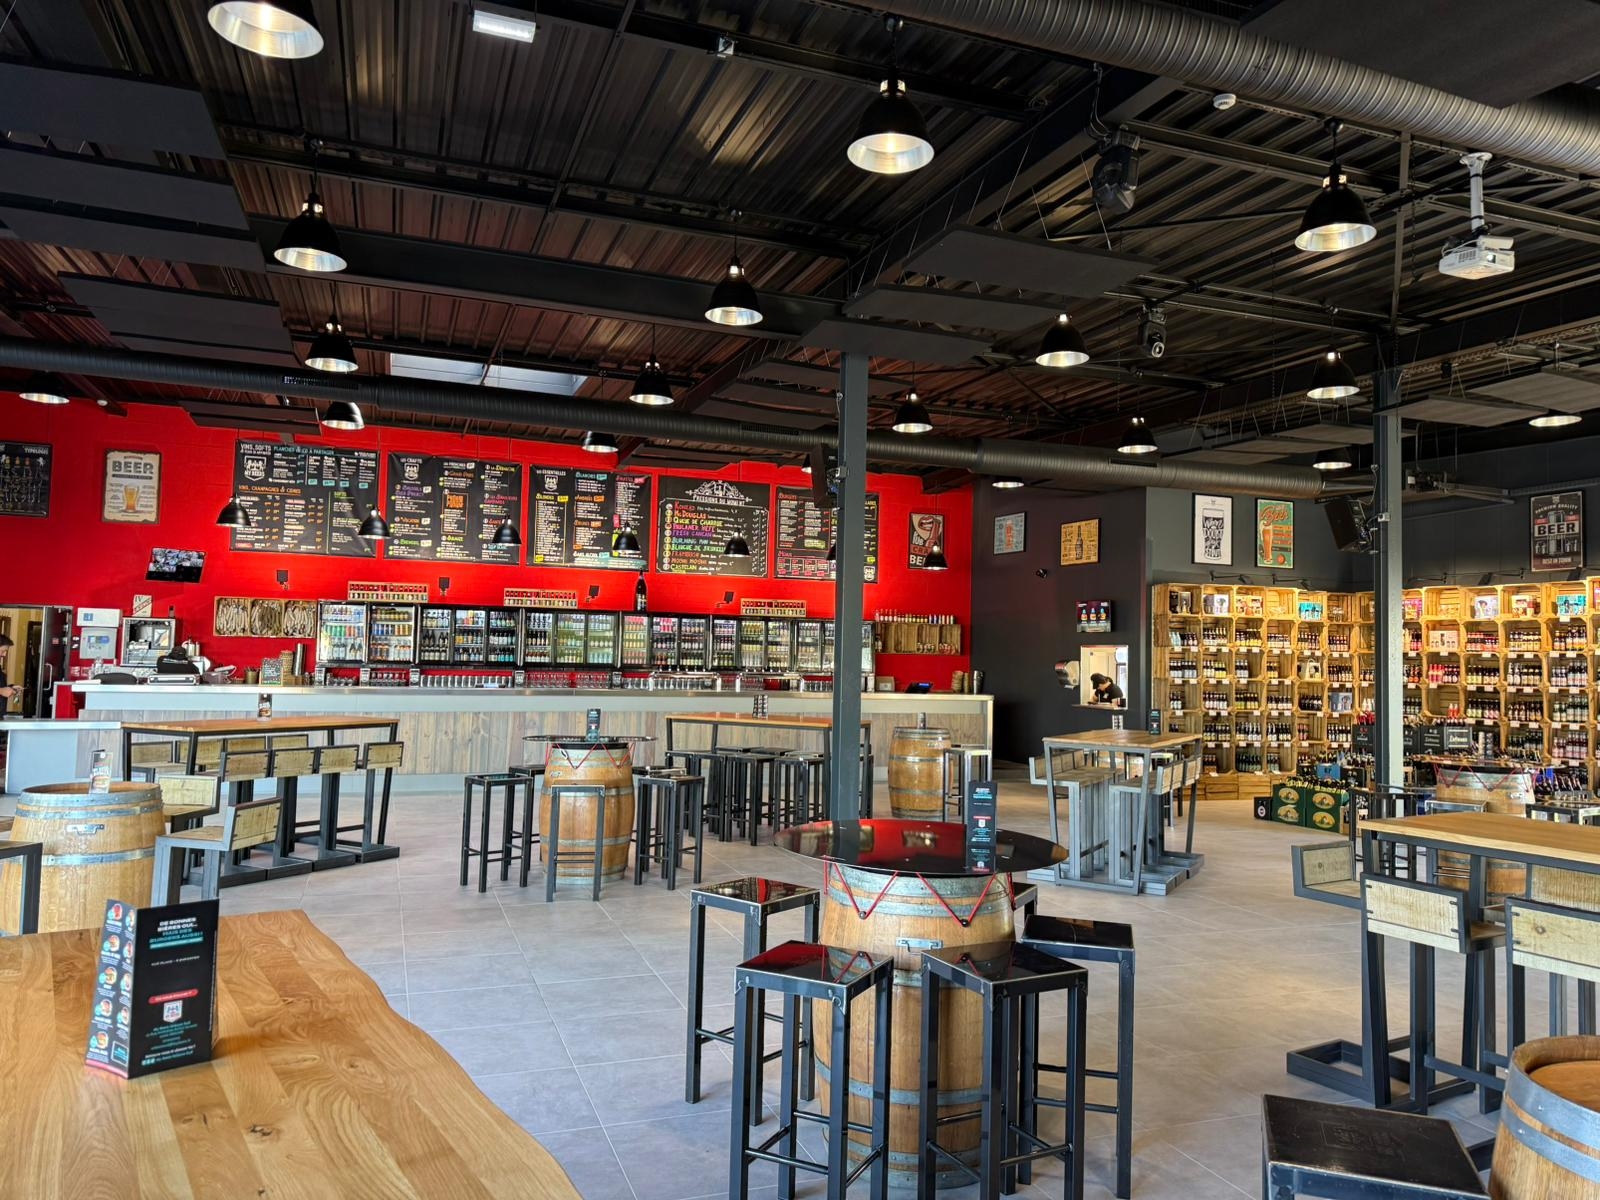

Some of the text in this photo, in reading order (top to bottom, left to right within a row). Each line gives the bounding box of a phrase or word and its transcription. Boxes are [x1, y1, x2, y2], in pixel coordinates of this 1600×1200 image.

[112, 461, 154, 474] BEER
[1535, 505, 1556, 514] PREMIUM
[1538, 522, 1575, 535] BEER
